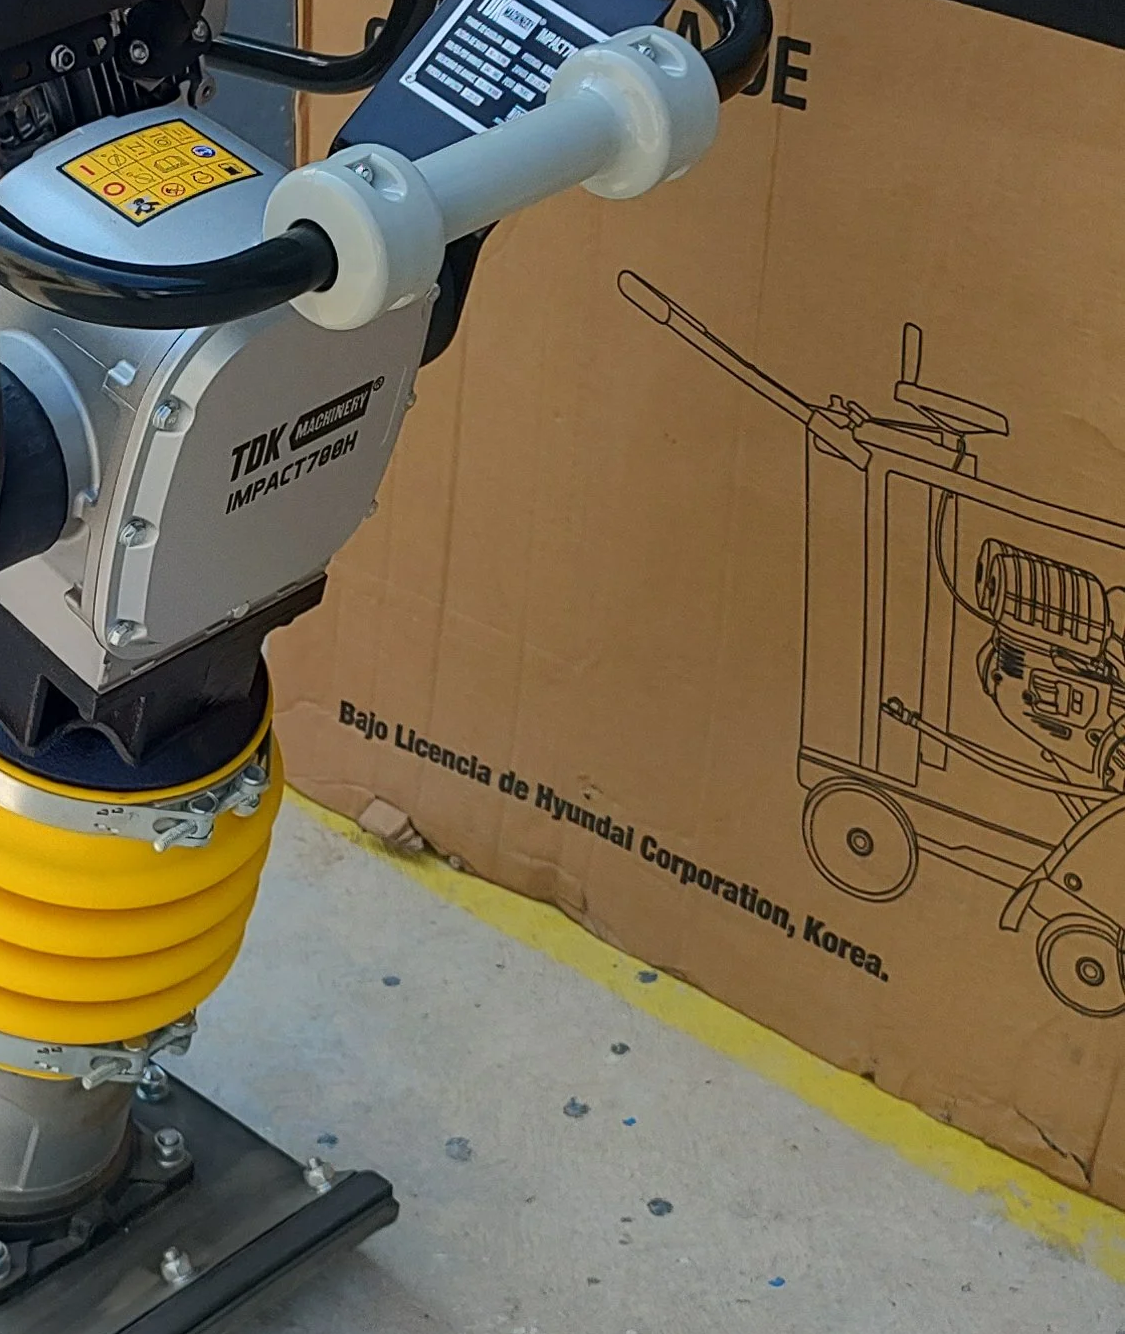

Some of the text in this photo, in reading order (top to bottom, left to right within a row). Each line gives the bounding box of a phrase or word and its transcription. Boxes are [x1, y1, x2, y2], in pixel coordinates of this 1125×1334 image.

[225, 430, 359, 515] IMPACT700H
[230, 390, 368, 482] TDK MACHINERY
[338, 700, 890, 981] Bajo Licencia de Hyundai Corporation, Korea.
